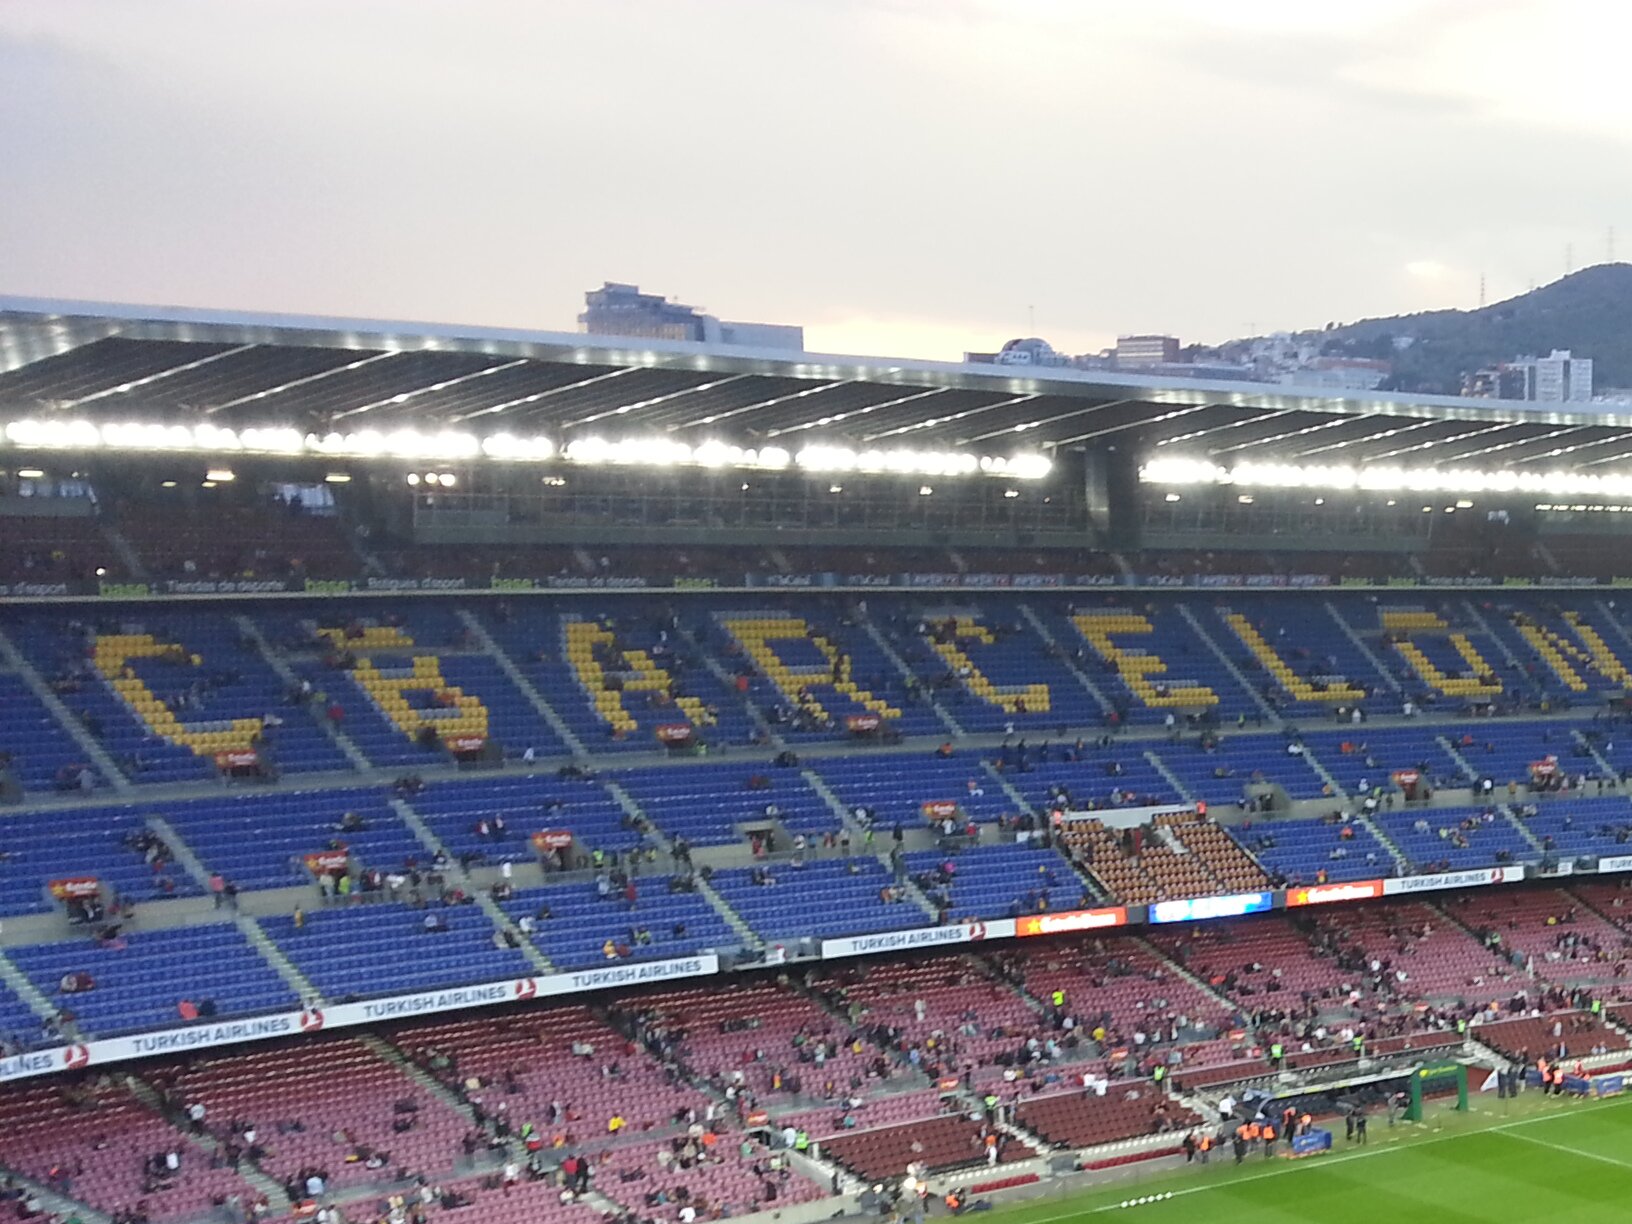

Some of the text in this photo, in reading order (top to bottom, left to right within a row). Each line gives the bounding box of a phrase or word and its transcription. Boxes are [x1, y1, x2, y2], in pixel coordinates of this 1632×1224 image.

[1400, 872, 1486, 890] TURKISH AIRLINES
[852, 928, 963, 951] TURKISH AIRLINES
[572, 959, 702, 988] TURKISH AIRLINES
[364, 985, 506, 1019] TURKISH AIRLINES
[133, 1018, 291, 1053] TURKISH AIRLINES
[0, 1054, 54, 1077] LINES
